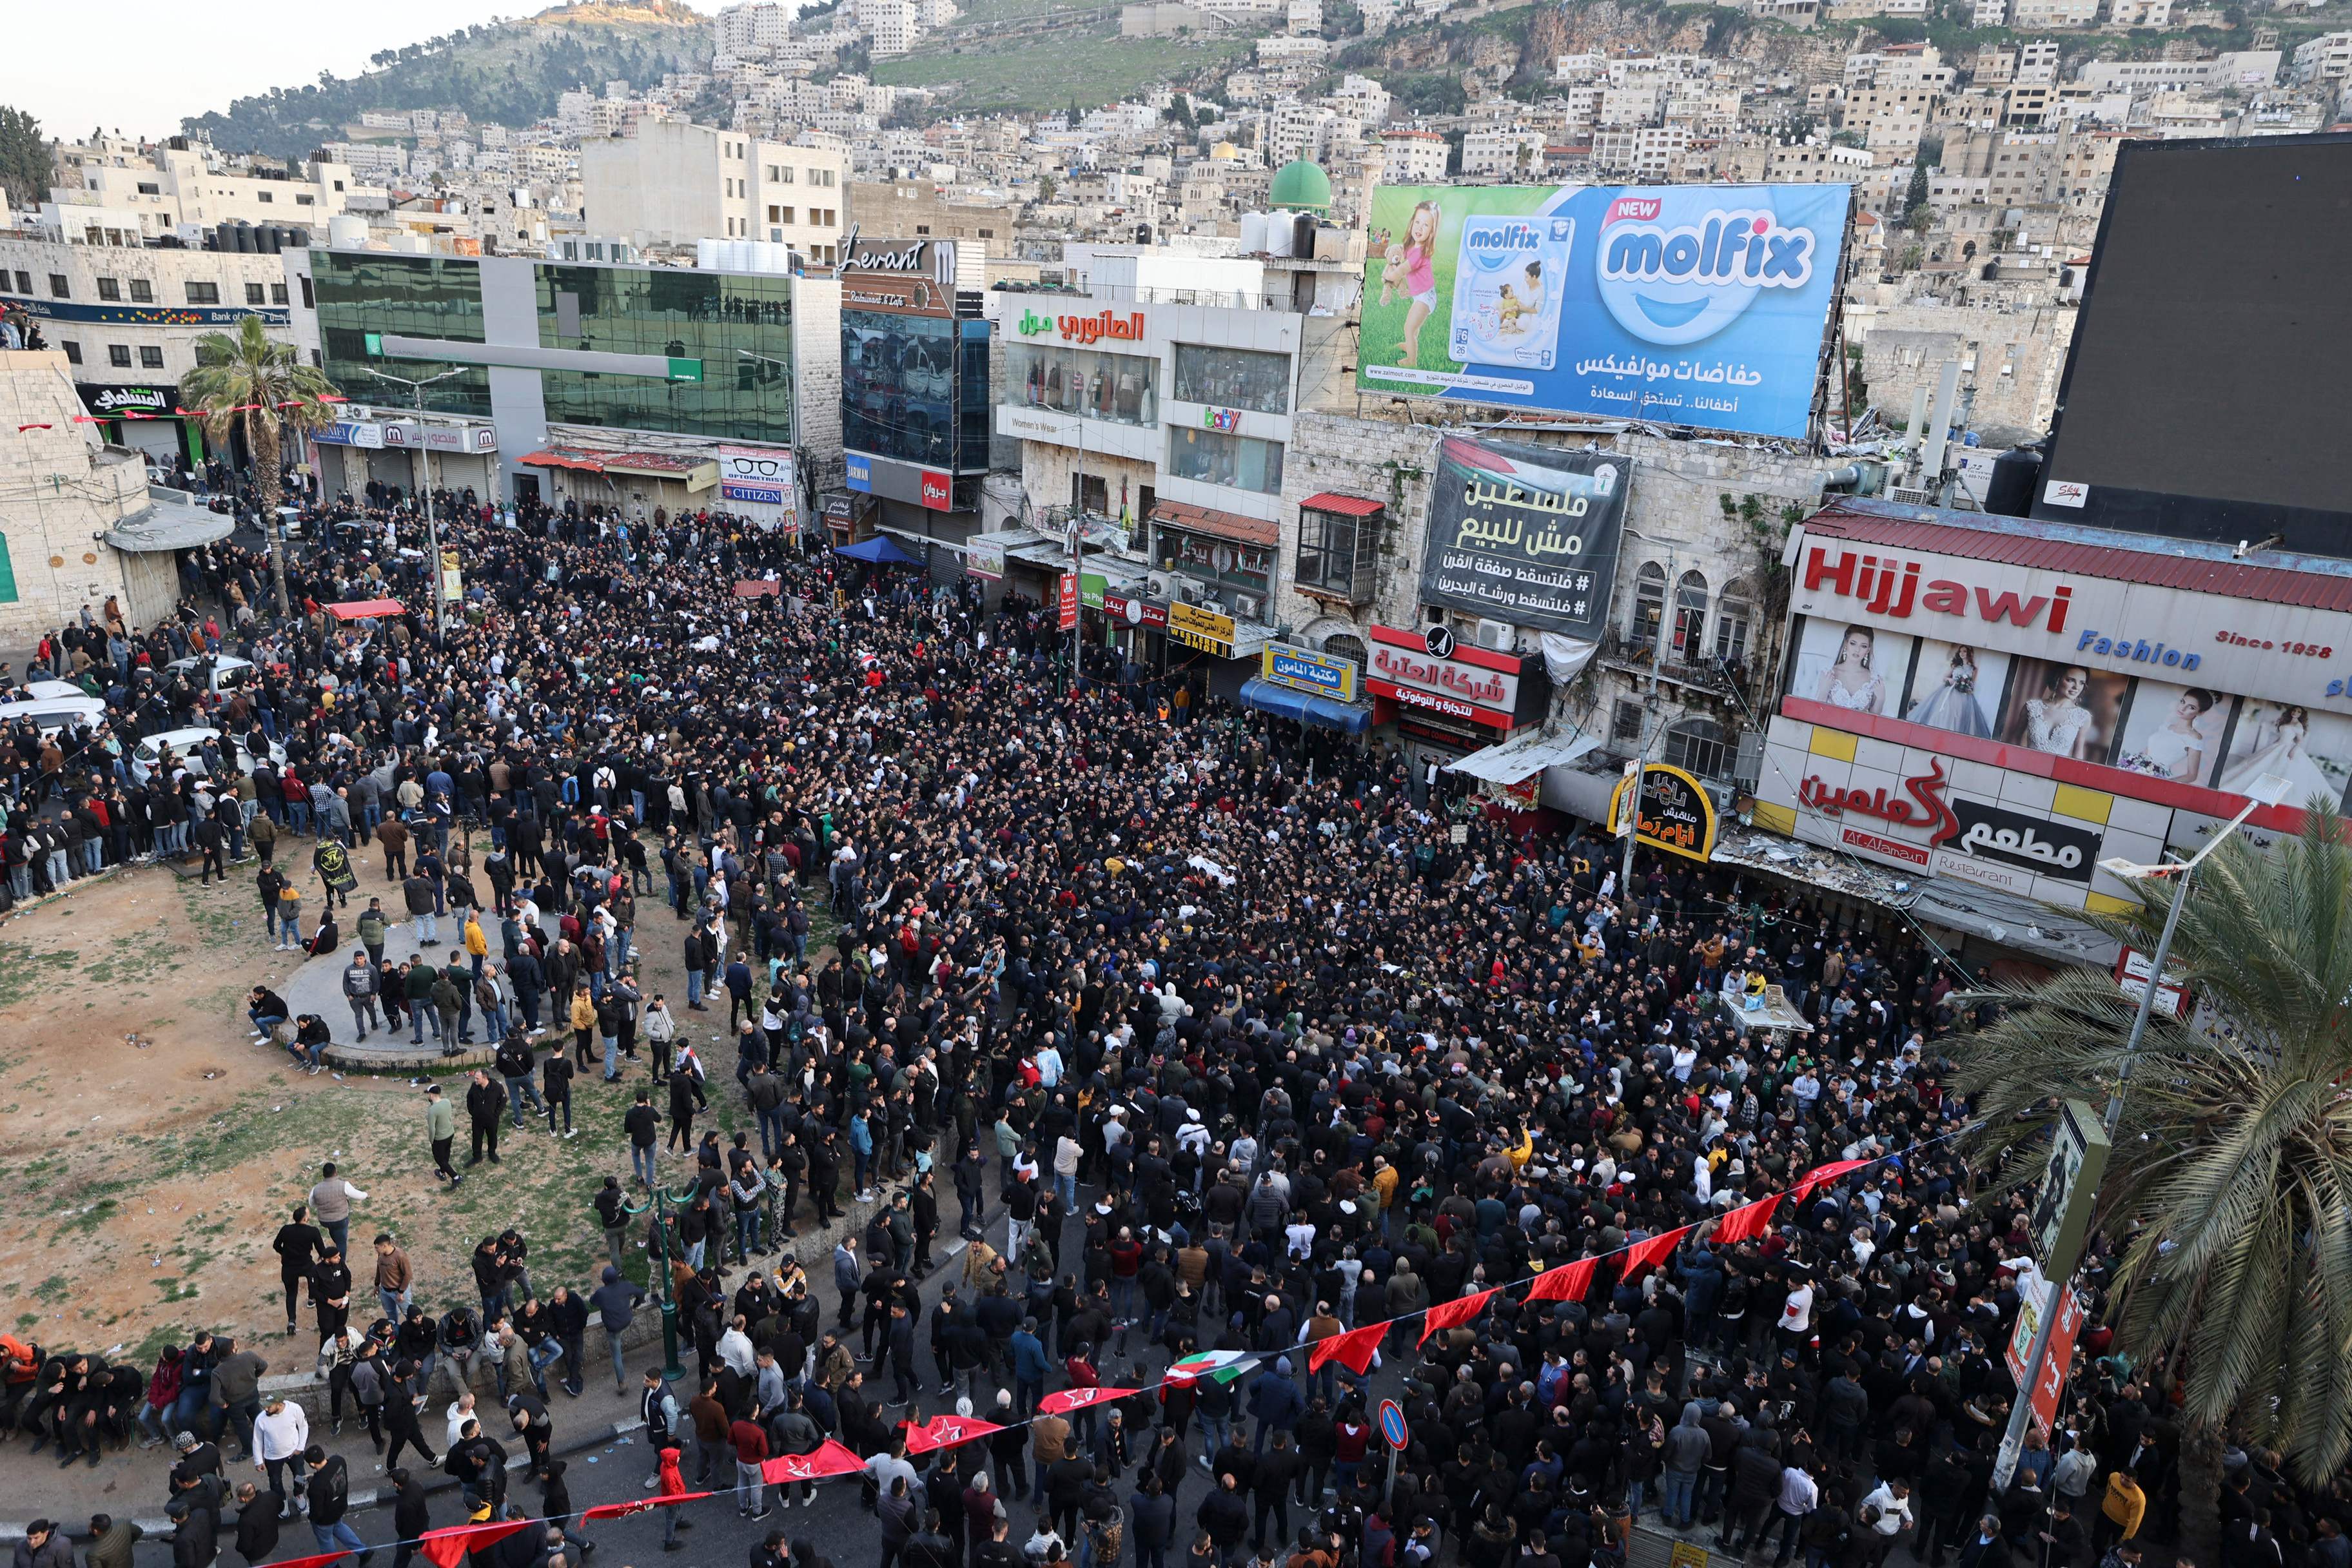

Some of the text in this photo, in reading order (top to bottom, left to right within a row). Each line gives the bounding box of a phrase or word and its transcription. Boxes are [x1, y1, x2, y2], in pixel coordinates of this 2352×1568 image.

[1618, 202, 1657, 217] NEW
[838, 221, 924, 271] Levant
[1470, 225, 1540, 249] molfix
[1607, 217, 1808, 279] molfix
[850, 291, 882, 305] Restaurant
[211, 312, 231, 321] Bank
[232, 312, 240, 321] of
[1019, 309, 1144, 344] الصانوري مول
[1456, 346, 1465, 354] 26
[1370, 369, 1416, 378] www.zalmout.com
[1576, 355, 1761, 386] حفاضات مولفيكس
[94, 389, 166, 409] المسلماني
[1590, 386, 1636, 400] السعادة
[1640, 391, 1683, 407] تستحق
[1012, 417, 1057, 434] Women's Wear
[1204, 406, 1241, 433] baby
[428, 432, 458, 445] منصور
[729, 473, 785, 483] OPTOMETRIST
[847, 465, 868, 482] JARWAN
[733, 488, 779, 502] CITIZEN
[923, 482, 947, 498] جروان
[1464, 473, 1589, 517] فلسطين
[2058, 484, 2081, 502] Sky
[1455, 518, 1582, 556] مش للبيع
[1442, 551, 1589, 591] # فلتسقط صفقة القرن
[1438, 576, 1476, 596] البحرين
[1804, 547, 2073, 633] Hijjawi
[1104, 600, 1164, 622] مستر بيكر
[1518, 594, 1571, 612] فلتسقط
[1574, 600, 1586, 615] #
[1170, 627, 1218, 648] WESTERN
[1184, 638, 1218, 655] UNION
[2215, 630, 2333, 659] Since 1958
[2076, 629, 2202, 671] Fashion
[1277, 660, 1337, 683] مكتبة المأمون
[1375, 649, 1505, 701] شركة العتبة
[1396, 688, 1472, 717] للتجارة و النوفوتية
[1663, 807, 1697, 823] مناقيش
[1961, 822, 2082, 868] مطعم
